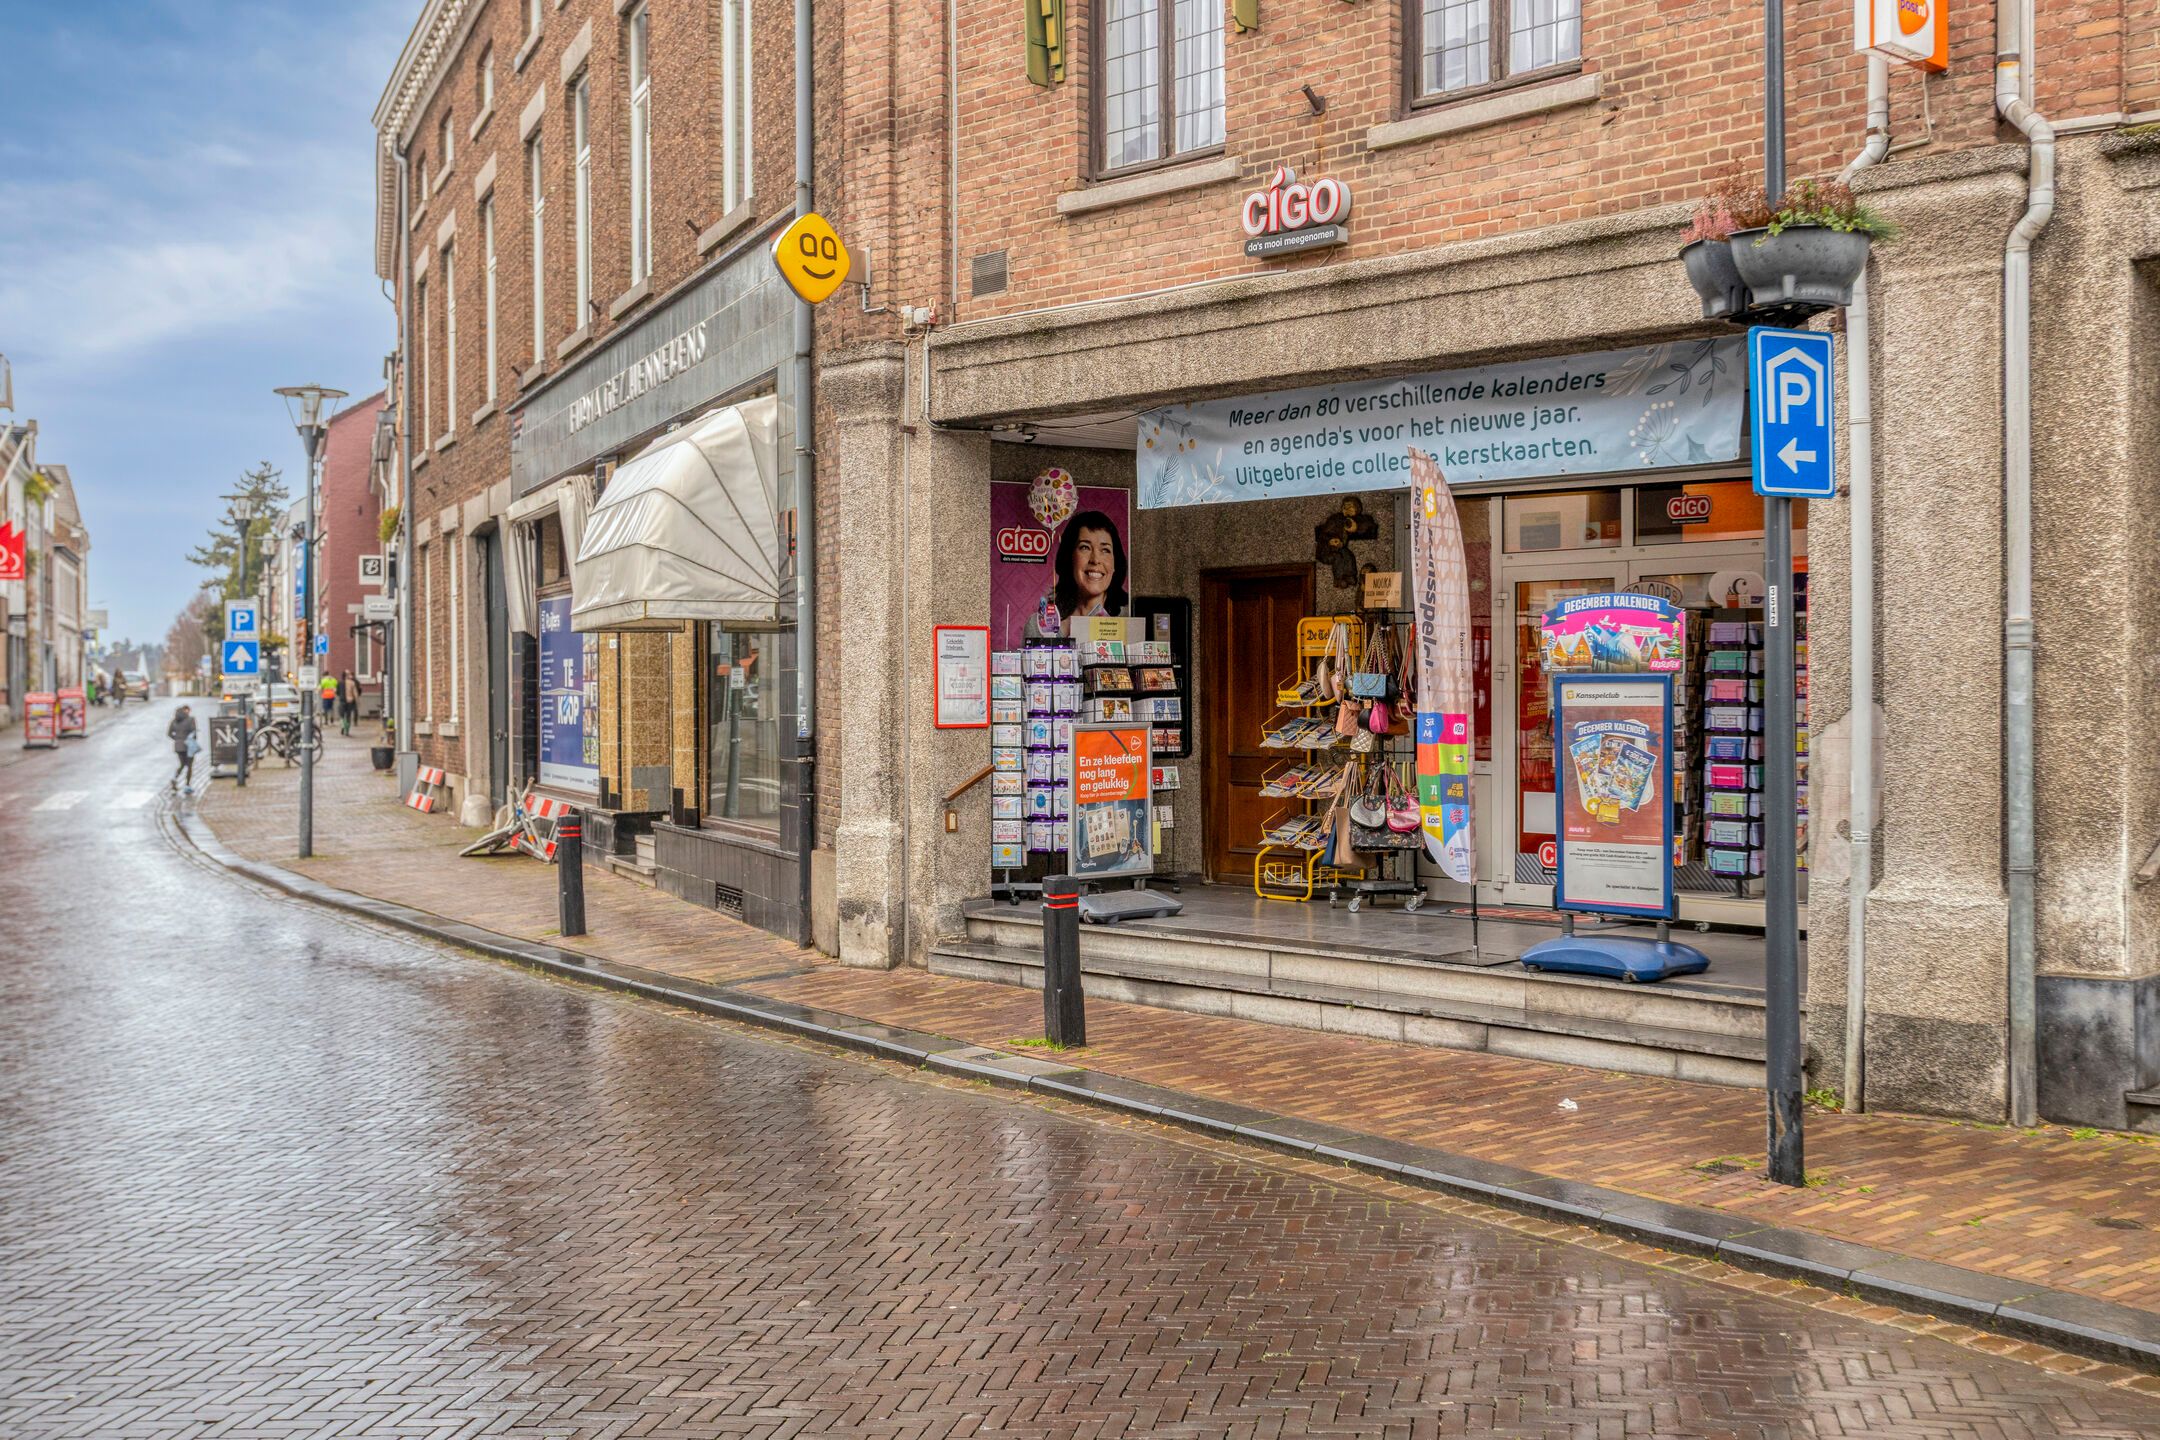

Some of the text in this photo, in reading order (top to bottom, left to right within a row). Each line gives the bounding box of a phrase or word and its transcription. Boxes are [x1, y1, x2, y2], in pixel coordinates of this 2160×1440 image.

[1247, 230, 1335, 252] da's mooi meegenomen
[1229, 371, 1607, 428] Meer dan 80 verschillende kalenders
[1779, 372, 1811, 424] P
[1243, 406, 1581, 455] en agenda's voor het nieuwe jaar.
[1235, 458, 1346, 487] Uitgebreide
[1445, 437, 1598, 466] kerstkaarten.
[1564, 595, 1660, 613] DECEMBER KALENDER
[235, 611, 250, 630] P
[563, 658, 574, 688] TE
[1575, 692, 1620, 700] Kansspelclub
[557, 695, 580, 725] KOOP
[1578, 723, 1647, 736] DECEMBER KALENDER
[1080, 754, 1142, 767] En ze kleefden
[1080, 768, 1116, 780] nog lang
[1080, 779, 1129, 793] en gelukkig
